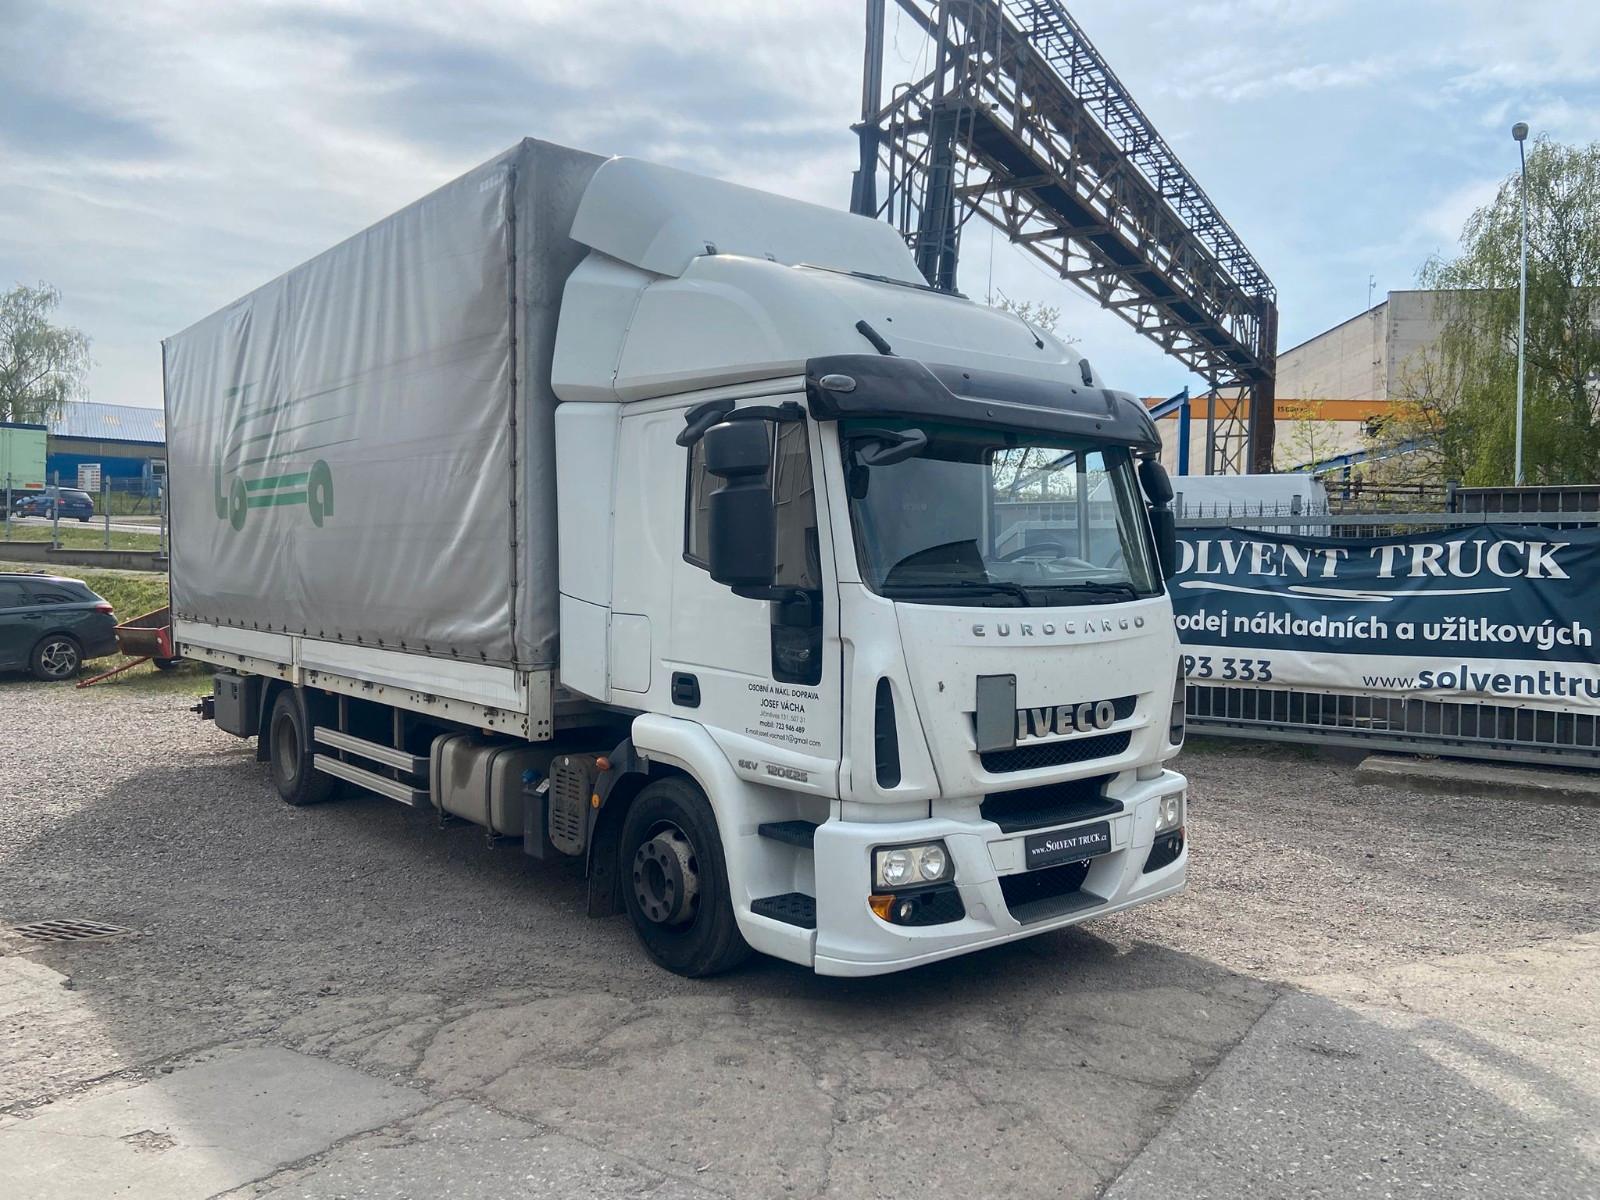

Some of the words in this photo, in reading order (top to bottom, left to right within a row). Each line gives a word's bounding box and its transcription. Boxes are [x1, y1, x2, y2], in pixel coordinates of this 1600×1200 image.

[1175, 539, 1349, 578] OLVENT
[1370, 540, 1571, 579] TRUCK
[972, 615, 1145, 637] EUROCARGO
[1174, 608, 1228, 637] odej
[1234, 611, 1388, 639] nákladních
[1396, 622, 1415, 640] a
[1423, 616, 1592, 650] užitkových
[1184, 655, 1213, 678] 93
[1222, 658, 1272, 682] 333
[760, 698, 779, 709] JOSEF
[780, 699, 805, 713] VÁCHA
[769, 686, 774, 694] A
[791, 689, 820, 701] DOPRAVA
[1017, 700, 1116, 740] IVECO
